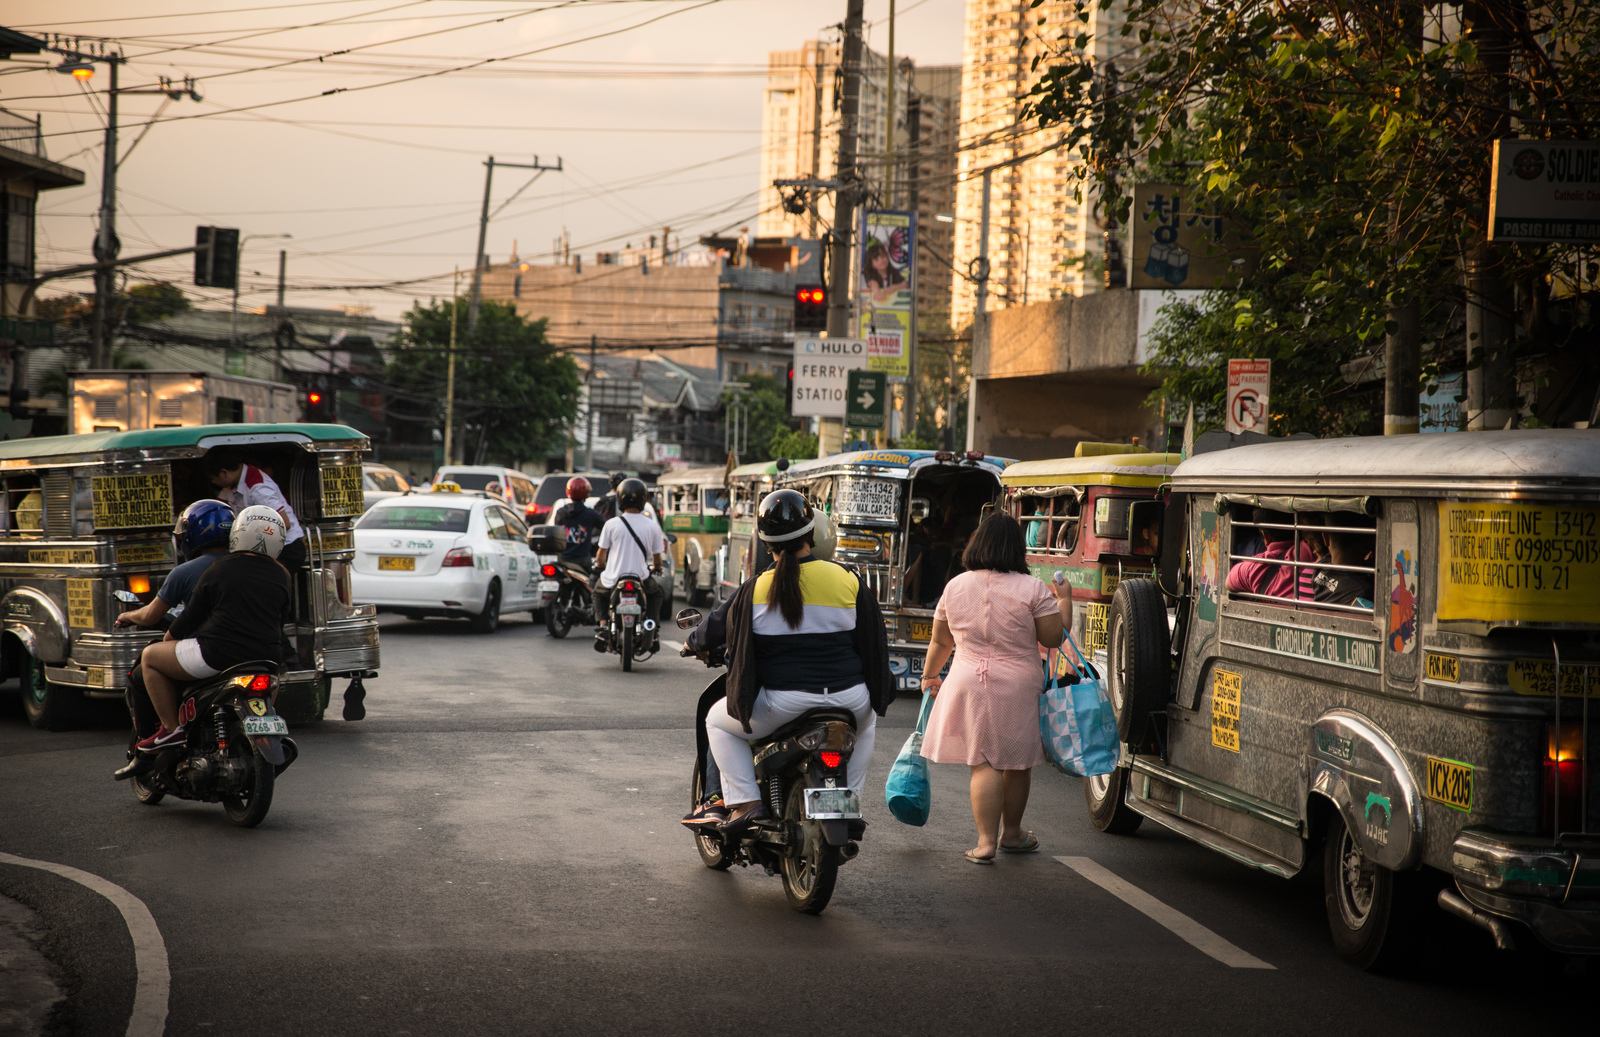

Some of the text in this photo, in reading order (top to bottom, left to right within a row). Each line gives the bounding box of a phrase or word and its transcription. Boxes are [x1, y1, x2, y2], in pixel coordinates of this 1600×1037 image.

[1503, 222, 1542, 237] PASIG
[1545, 223, 1573, 238] LINE
[821, 343, 863, 354] HULO
[802, 365, 845, 378] FERRY
[1230, 374, 1266, 384] NO PARKING
[874, 483, 893, 495] 1342
[1490, 510, 1542, 535] HOTLINE
[1555, 511, 1596, 537] 1342
[1478, 536, 1510, 561] HOTLINE
[1552, 565, 1569, 590] 21
[1275, 627, 1315, 657] GUADALUPE
[1429, 655, 1456, 680] FOR HIRE
[1515, 661, 1537, 673] MAY
